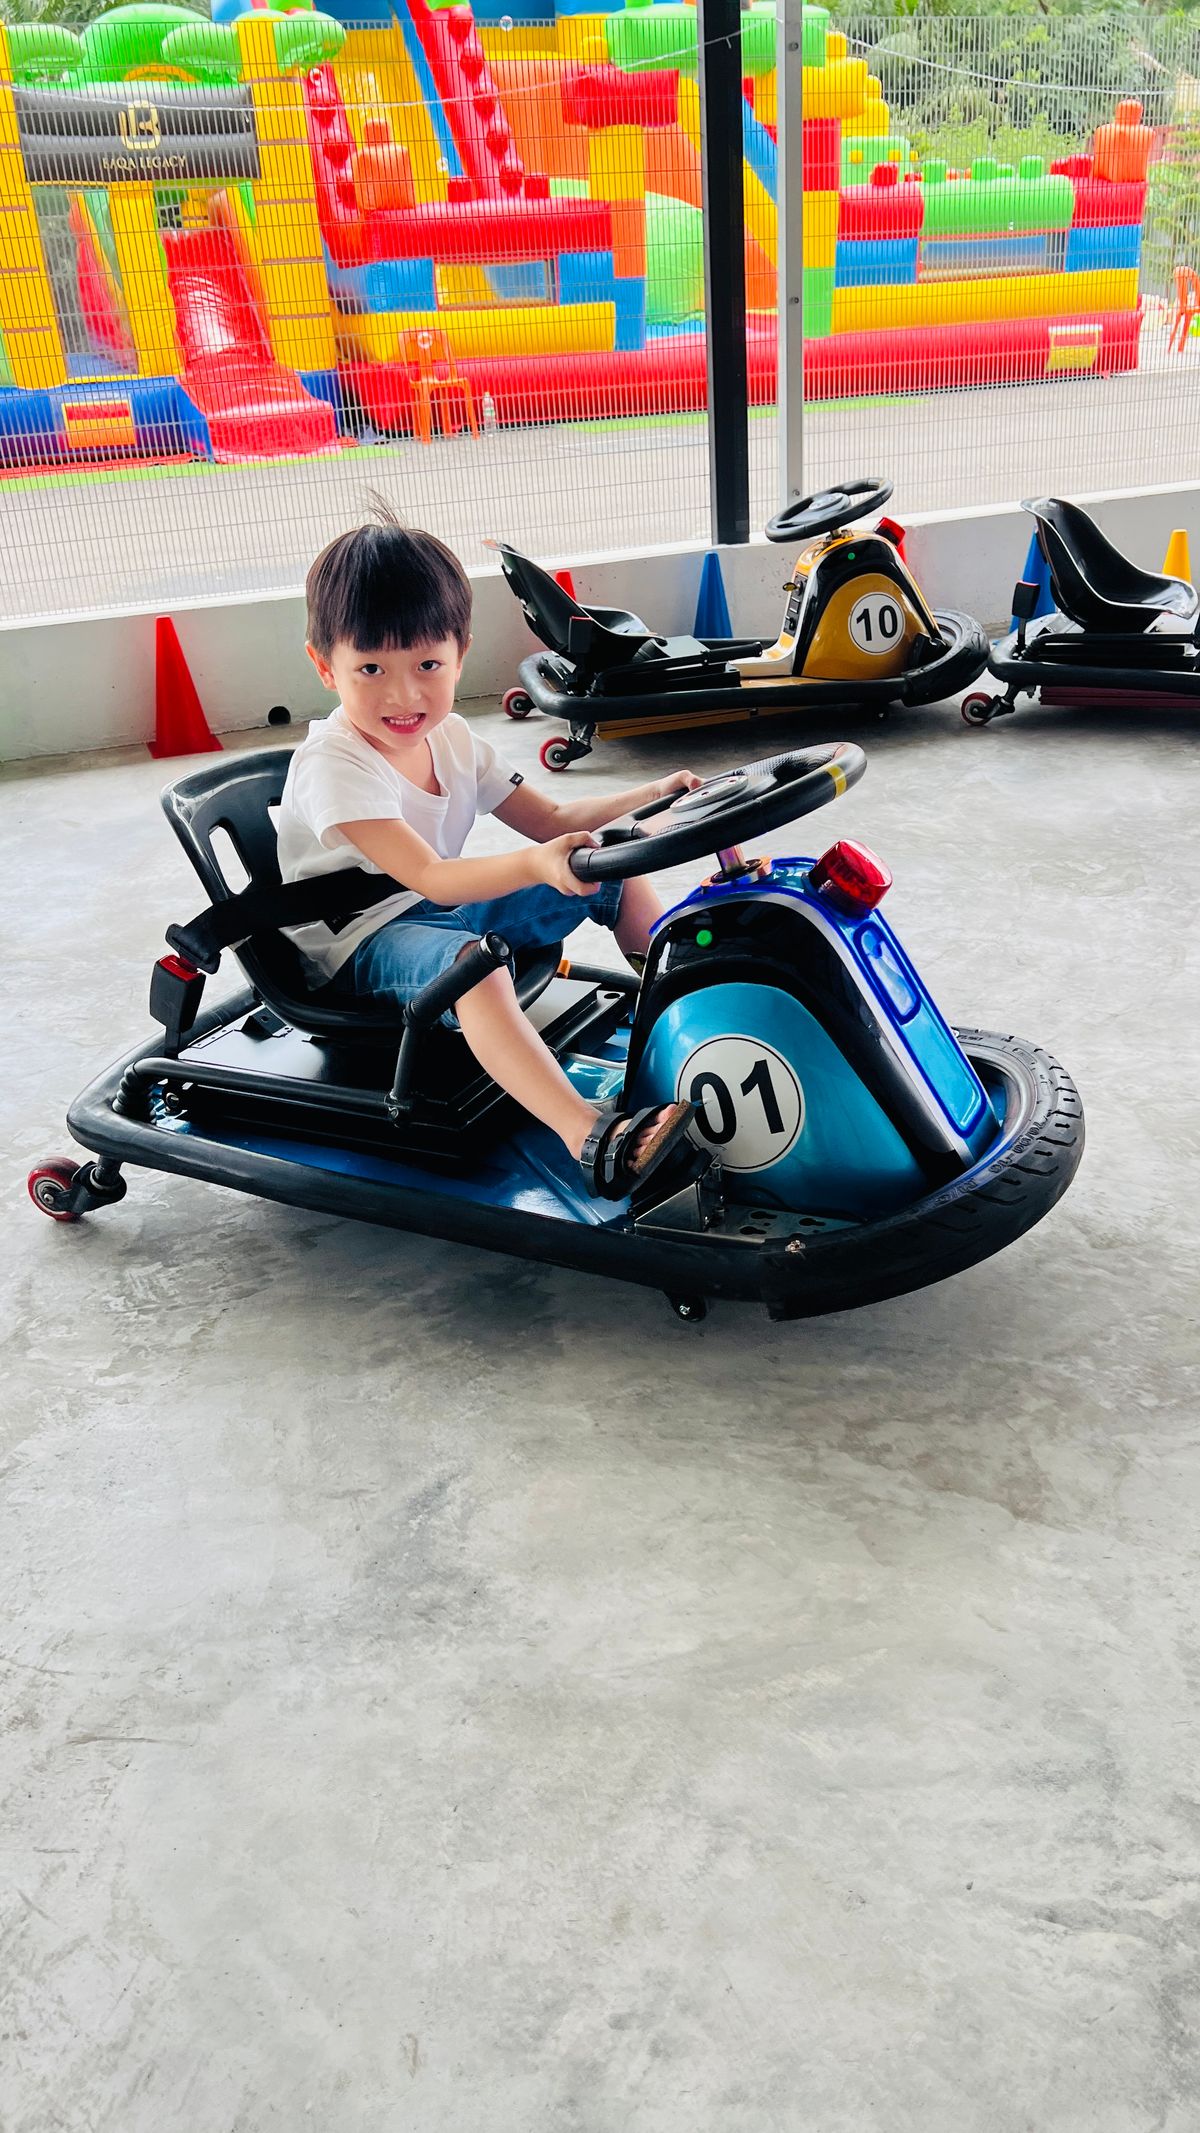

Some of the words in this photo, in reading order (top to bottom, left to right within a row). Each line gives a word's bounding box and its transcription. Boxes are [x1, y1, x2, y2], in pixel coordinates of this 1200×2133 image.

[139, 154, 187, 169] LEGACY
[856, 605, 898, 642] 10
[690, 1058, 785, 1145] 01
